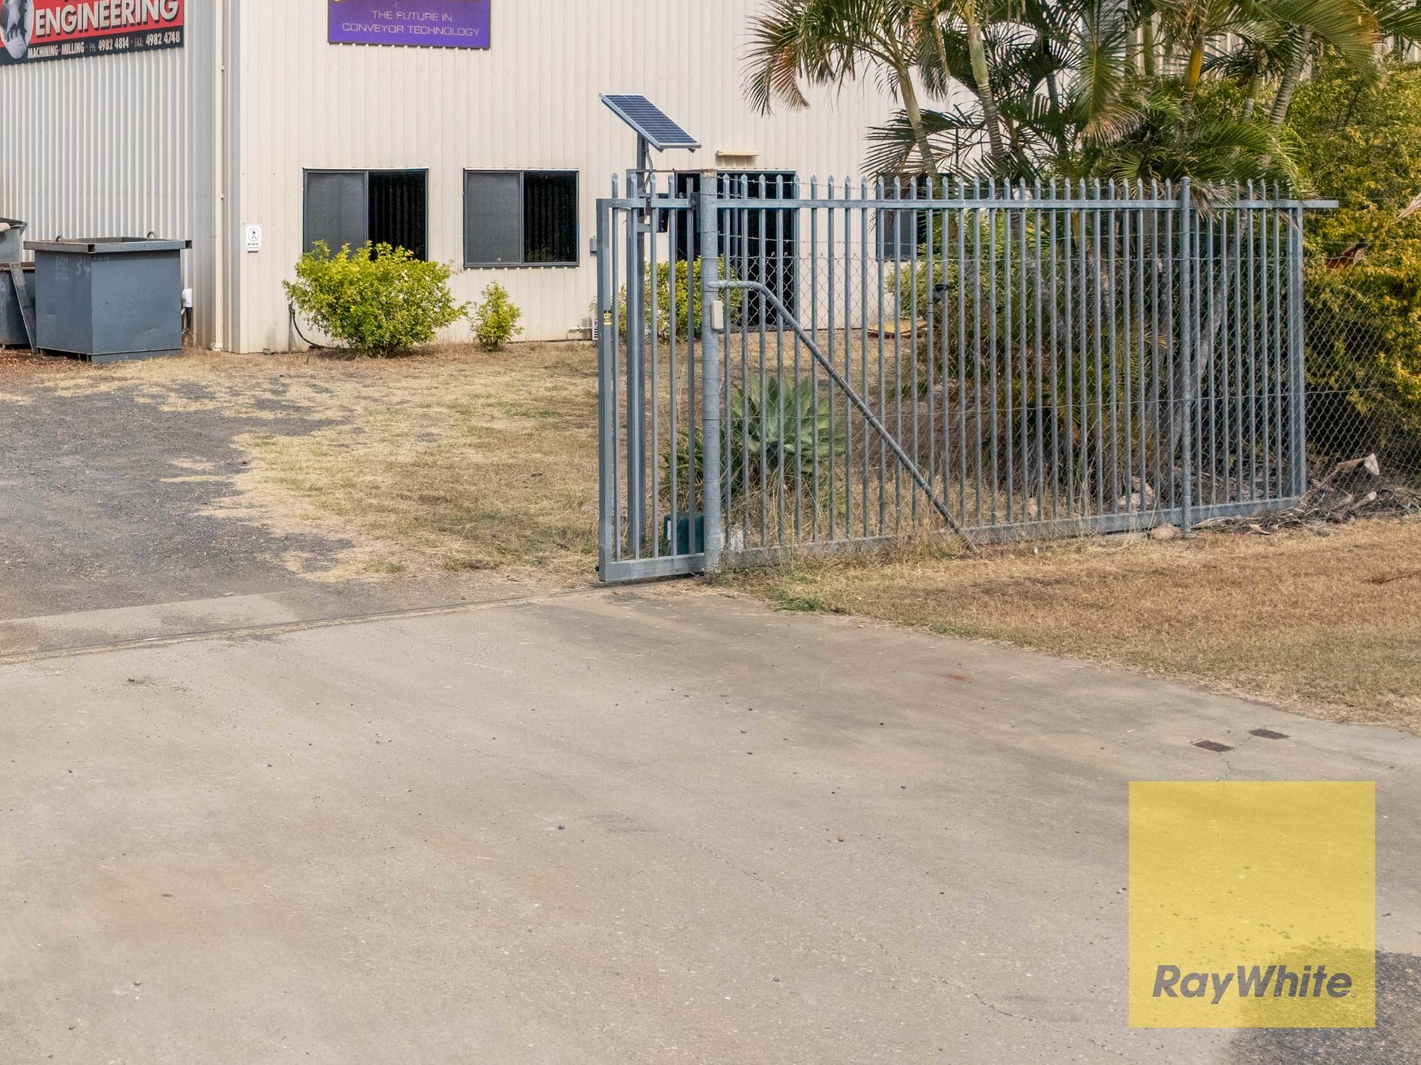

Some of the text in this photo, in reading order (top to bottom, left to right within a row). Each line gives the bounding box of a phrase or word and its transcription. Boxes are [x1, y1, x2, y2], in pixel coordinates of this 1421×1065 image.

[372, 10, 453, 22] THE FUTURE IN
[342, 22, 481, 37] CONVEYOR TECHNOLOGY
[97, 39, 113, 51] 4982
[145, 32, 162, 46] 4982
